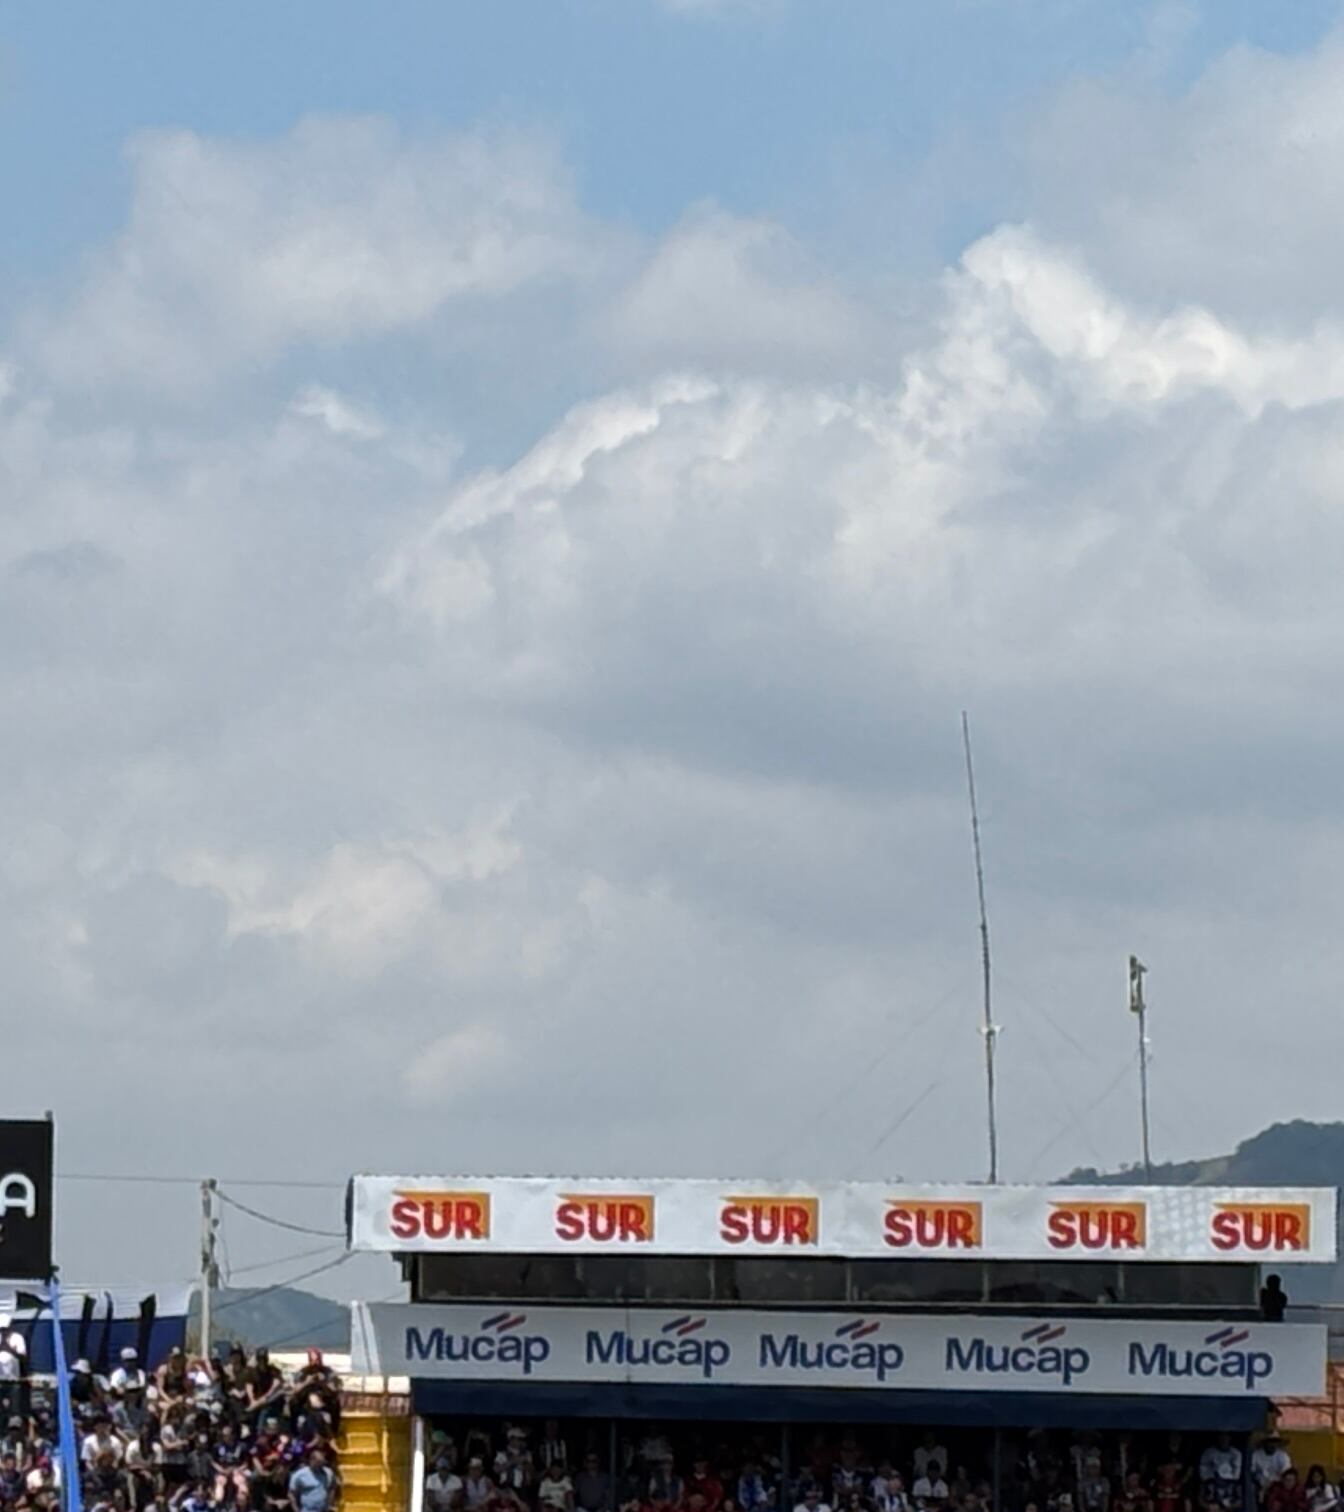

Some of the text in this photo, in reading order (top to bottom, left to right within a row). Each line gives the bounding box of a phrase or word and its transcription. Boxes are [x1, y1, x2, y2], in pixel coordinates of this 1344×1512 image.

[390, 1201, 483, 1239] SUR
[556, 1203, 648, 1242] SUR
[720, 1205, 812, 1245] SUR
[883, 1209, 975, 1248] SUR
[1048, 1210, 1138, 1250] SUR
[1211, 1211, 1303, 1251] SUR
[405, 1327, 550, 1374] Mucap
[586, 1331, 731, 1377] Mucap
[760, 1334, 904, 1381] Mucap
[945, 1338, 1090, 1385] Mucap
[1128, 1342, 1274, 1389] Mucap
